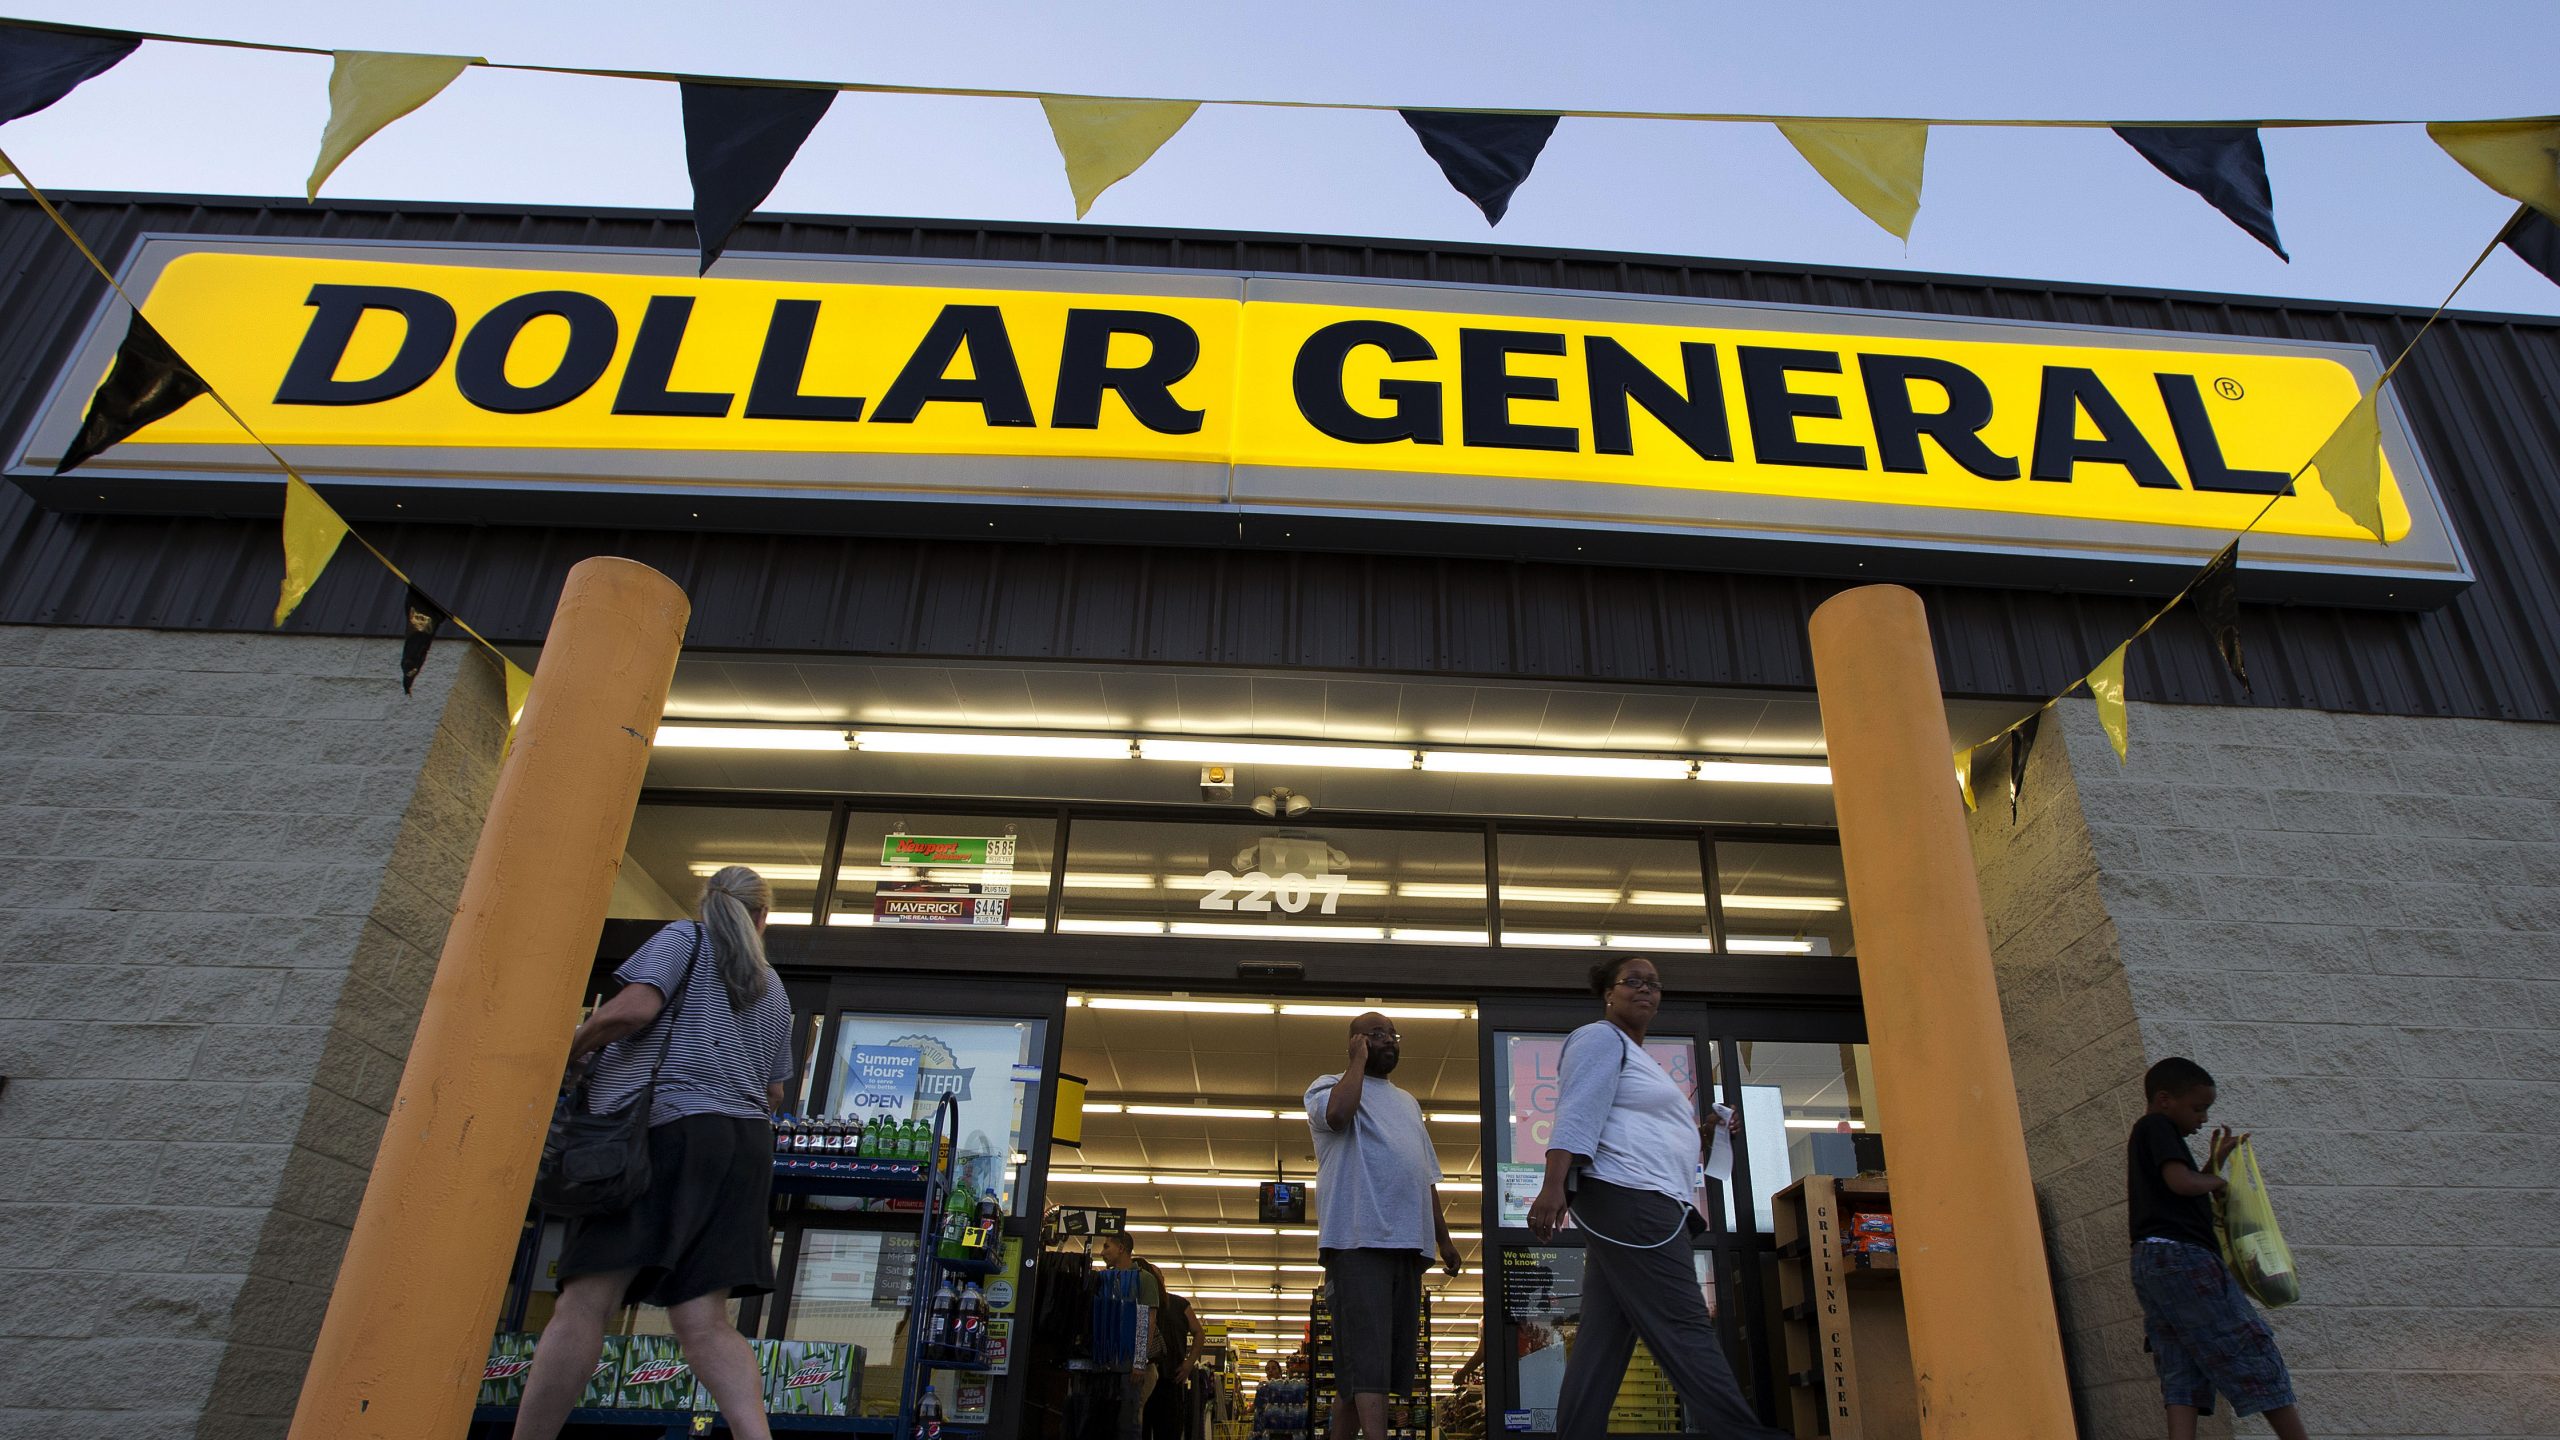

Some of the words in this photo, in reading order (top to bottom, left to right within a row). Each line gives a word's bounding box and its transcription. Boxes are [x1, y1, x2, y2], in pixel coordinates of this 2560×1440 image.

[272, 283, 1206, 434] DOLLAR
[1292, 319, 2297, 496] GENERAL
[896, 839, 958, 855] Newport
[1199, 870, 1348, 914] 2207
[889, 902, 958, 913] MAVERICK
[856, 1052, 916, 1067] Summer
[862, 1065, 905, 1078] Hours
[854, 1093, 903, 1108] OPEN
[888, 1236, 920, 1248] Store
[966, 1228, 985, 1246] $1
[1503, 1251, 1517, 1259] We
[1541, 1252, 1557, 1260] you
[1817, 1206, 1837, 1315] GRILLING
[1831, 1332, 1849, 1417] CENTER
[962, 1389, 981, 1397] We
[679, 1396, 690, 1404] 24
[833, 1402, 843, 1410] 24
[959, 1395, 984, 1405] Card
